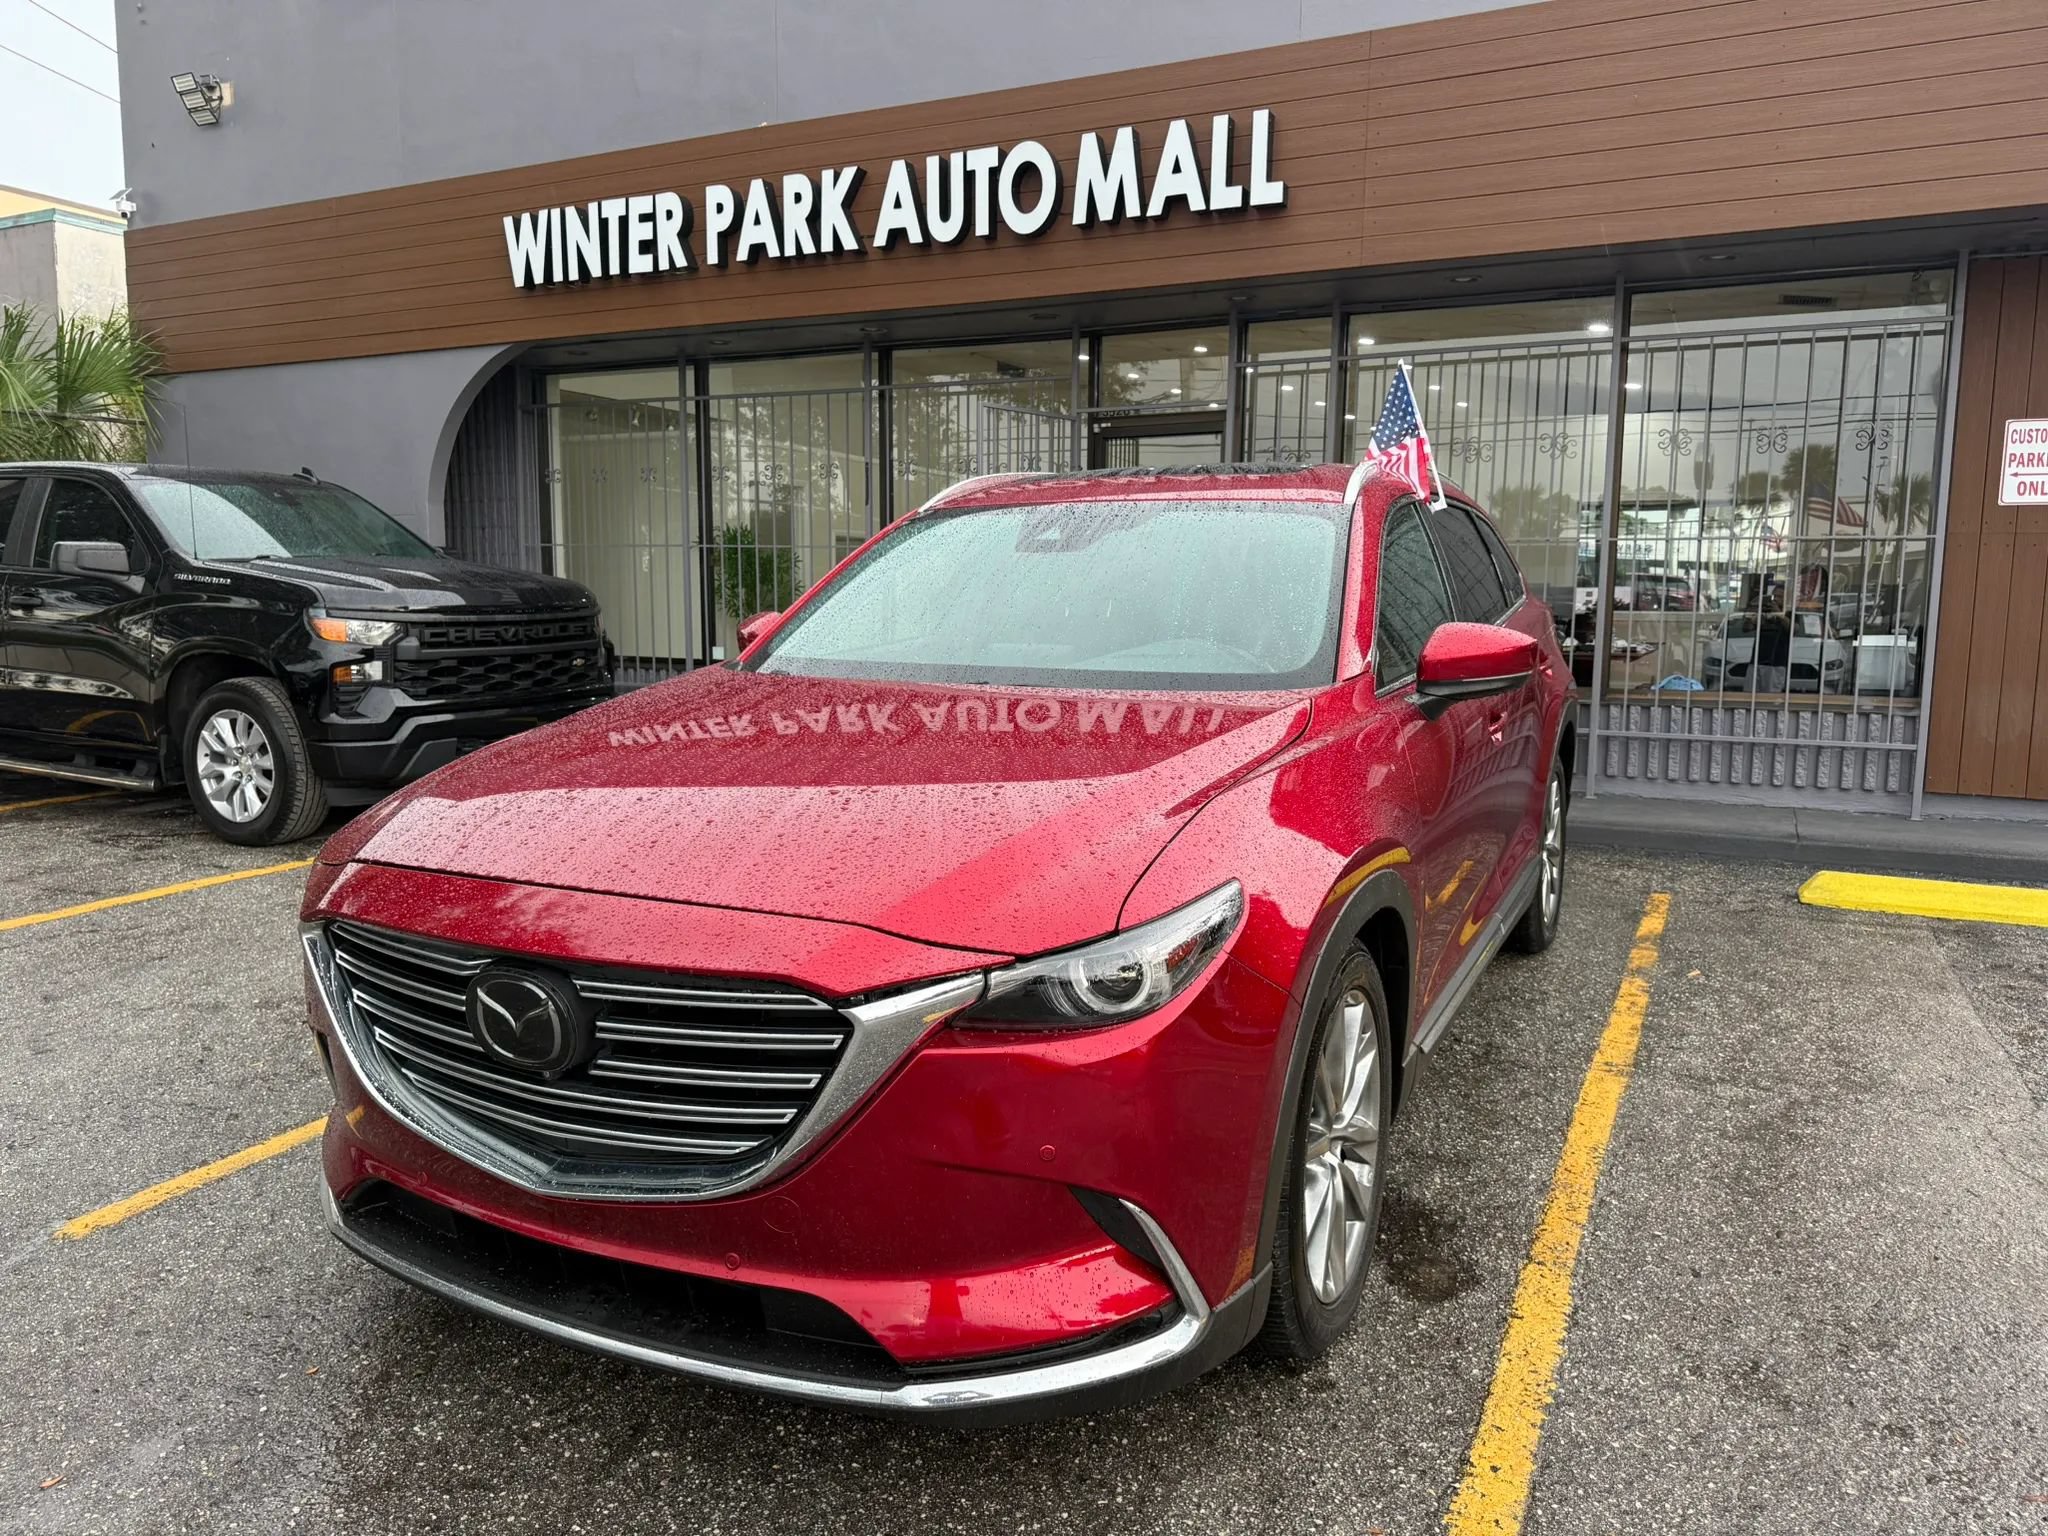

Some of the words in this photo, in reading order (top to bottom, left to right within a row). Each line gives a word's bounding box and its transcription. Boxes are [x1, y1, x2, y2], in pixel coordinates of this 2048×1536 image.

[502, 191, 692, 288] WINTER
[705, 165, 863, 266] PARK
[872, 140, 1059, 248] AUTO
[1072, 108, 1285, 226] MALL
[2010, 428, 2048, 444] CUSTO
[2016, 480, 2048, 496] ONL
[173, 572, 232, 585] SILVERADO
